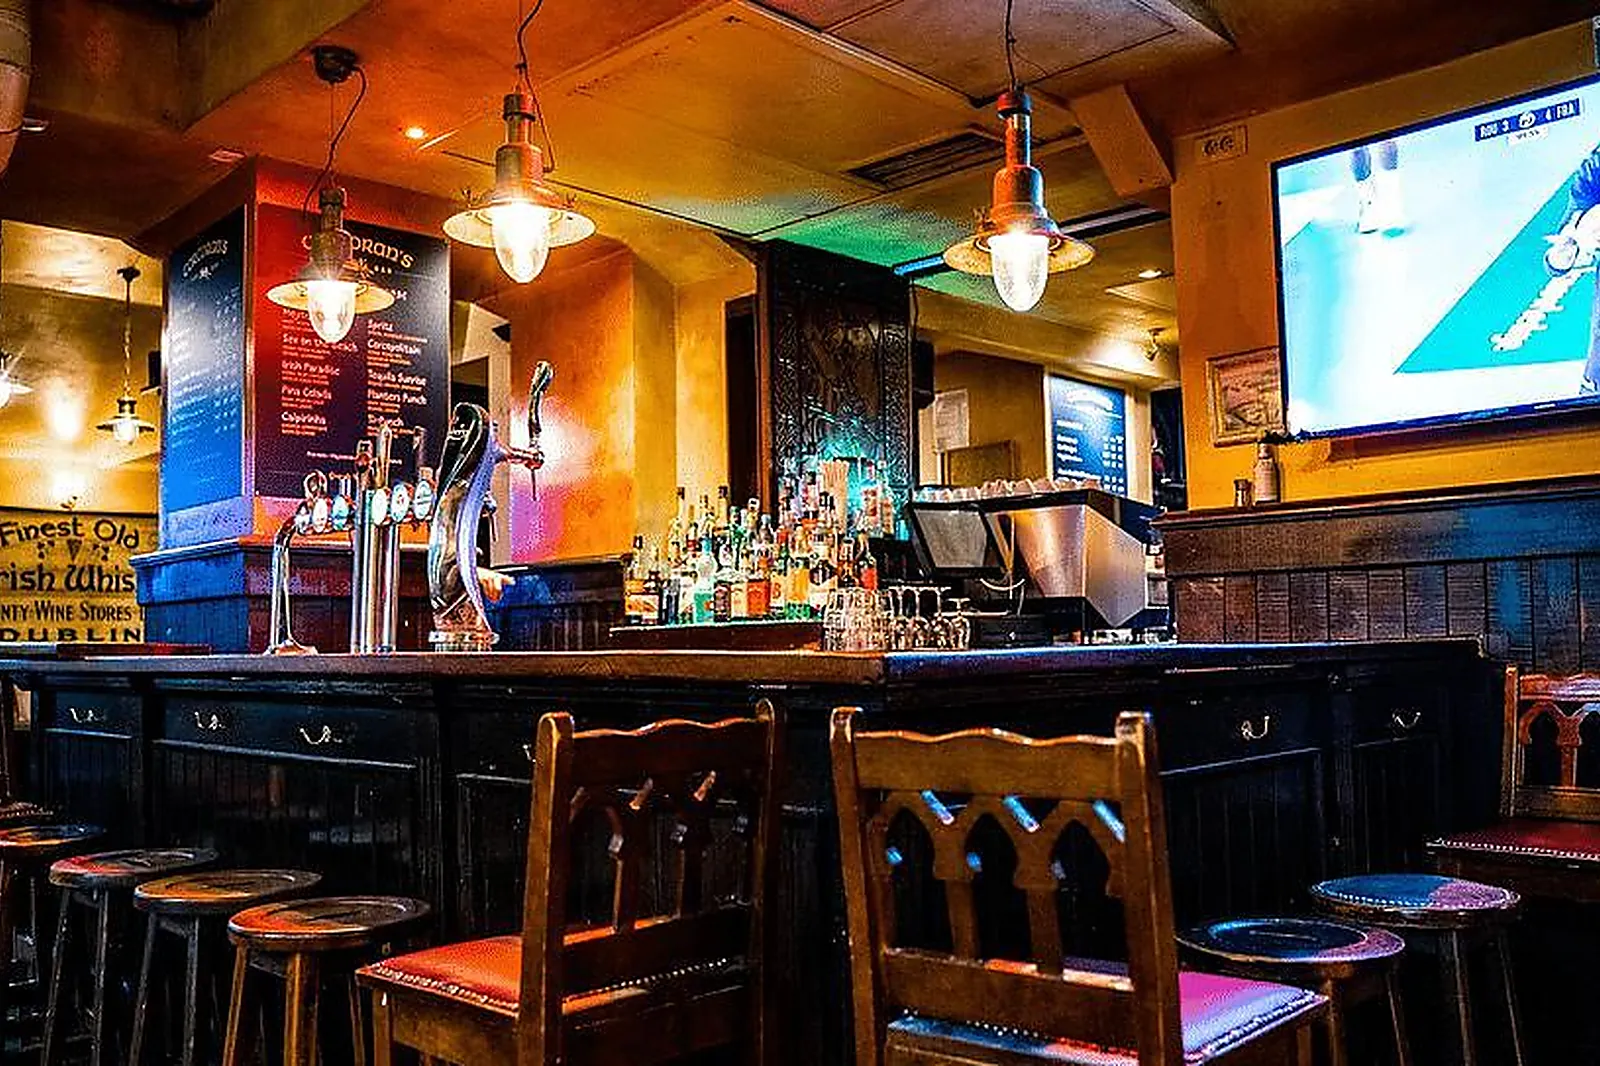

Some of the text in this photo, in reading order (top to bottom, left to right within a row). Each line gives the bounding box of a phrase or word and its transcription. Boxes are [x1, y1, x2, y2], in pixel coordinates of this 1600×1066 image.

[0, 517, 140, 549] Finest Old
[64, 564, 136, 593] Whis
[1, 604, 30, 622] NTY
[34, 599, 75, 622] WINE
[80, 599, 132, 622] STORES
[0, 627, 141, 642] DUBLIN
